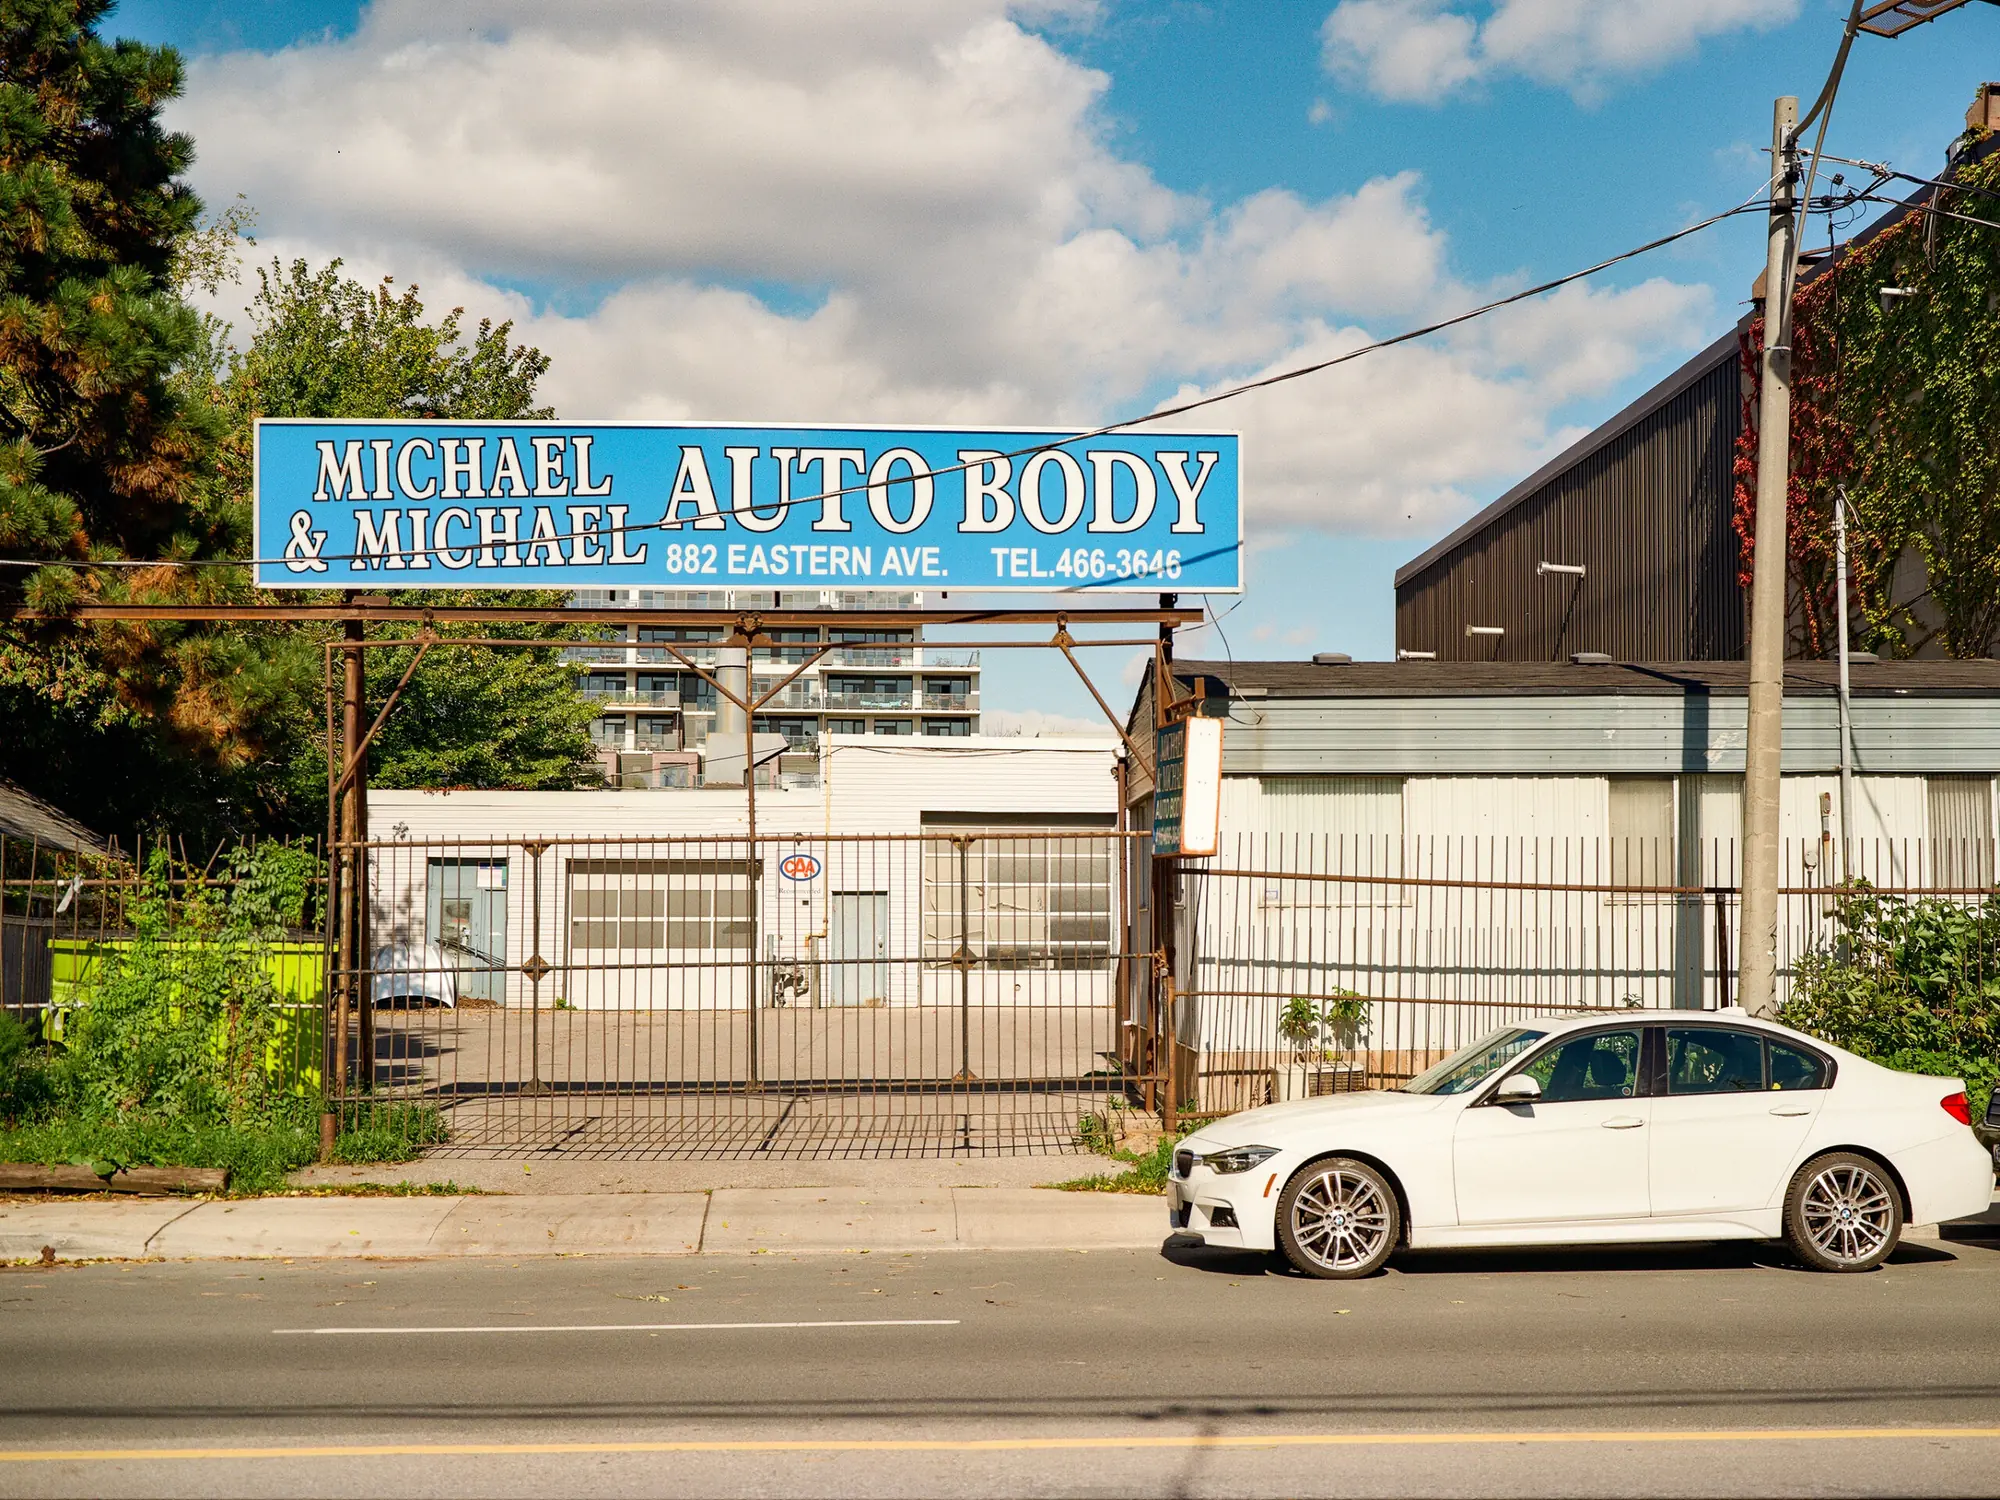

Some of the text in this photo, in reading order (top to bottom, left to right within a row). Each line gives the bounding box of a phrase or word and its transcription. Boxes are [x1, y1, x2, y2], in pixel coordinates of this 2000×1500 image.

[313, 435, 613, 502] MICHAEL
[659, 444, 1219, 536] AUTO BODY
[283, 505, 648, 573] & MICHAEL
[665, 544, 718, 575] 882
[727, 544, 876, 576] EASTERN
[880, 546, 948, 578] AVE.
[784, 858, 815, 877] CAA
